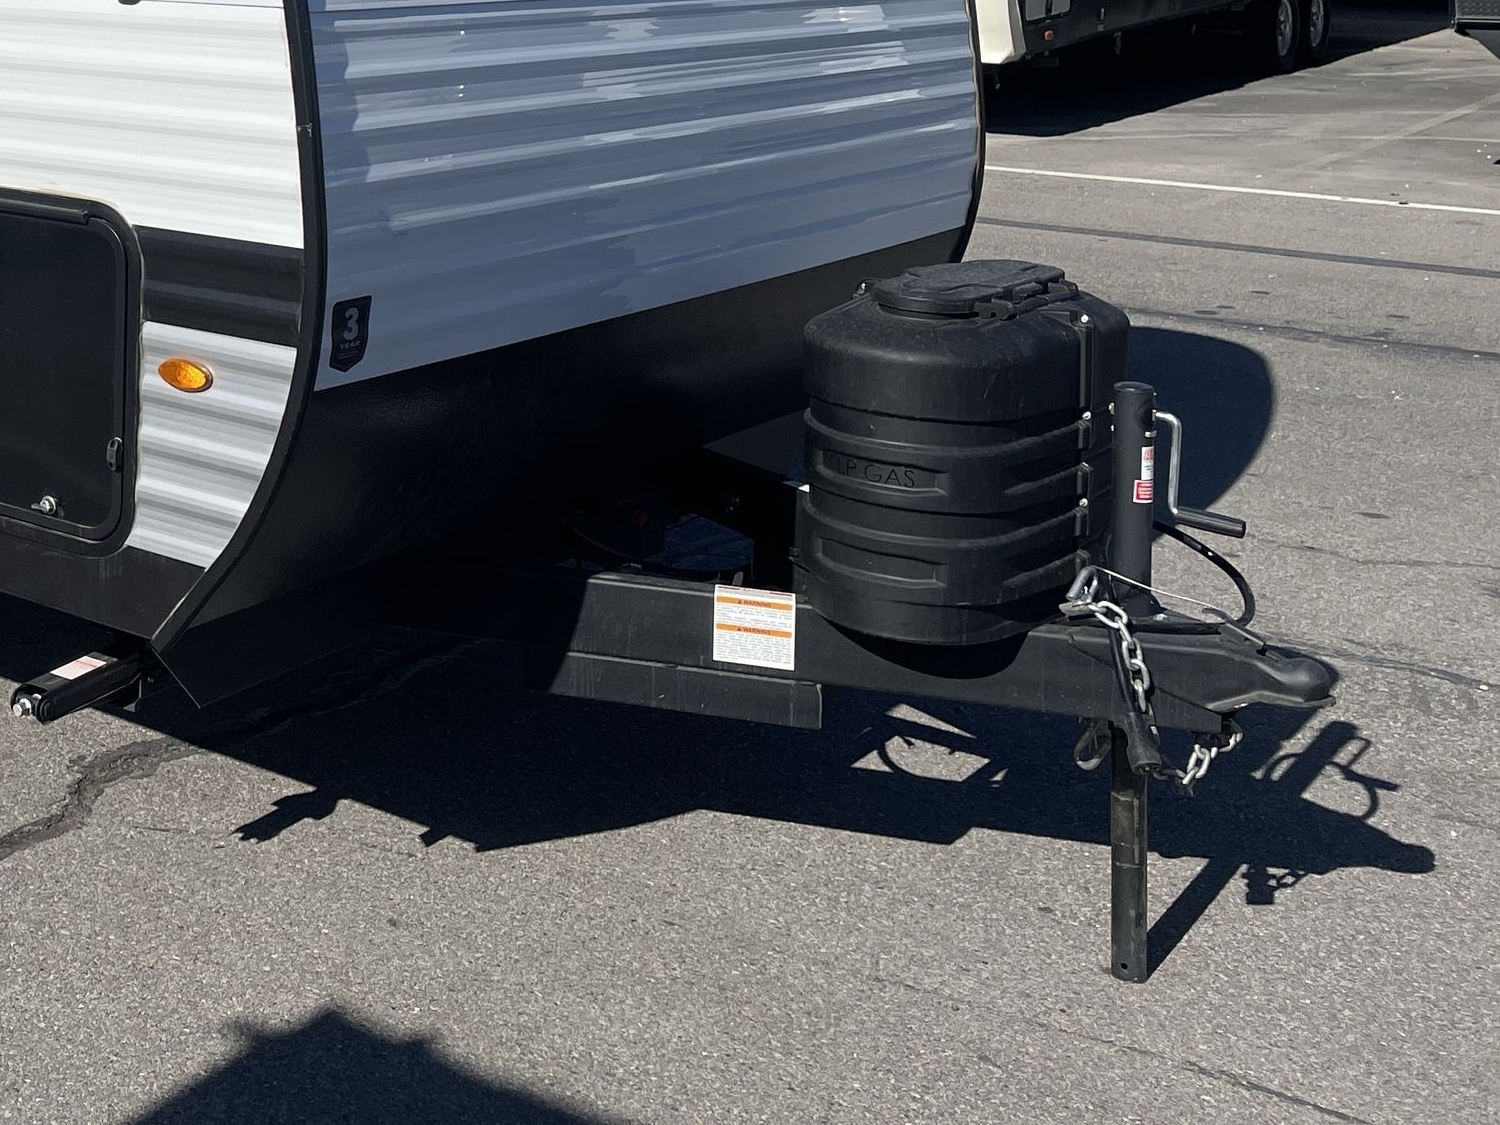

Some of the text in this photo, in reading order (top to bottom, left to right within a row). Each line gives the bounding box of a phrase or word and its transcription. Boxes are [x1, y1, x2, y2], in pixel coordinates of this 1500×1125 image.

[343, 307, 359, 340] 3
[339, 340, 361, 350] YEAR
[838, 457, 915, 488] LP GAS
[743, 599, 772, 608] WARNING
[742, 626, 771, 636] WARNING
